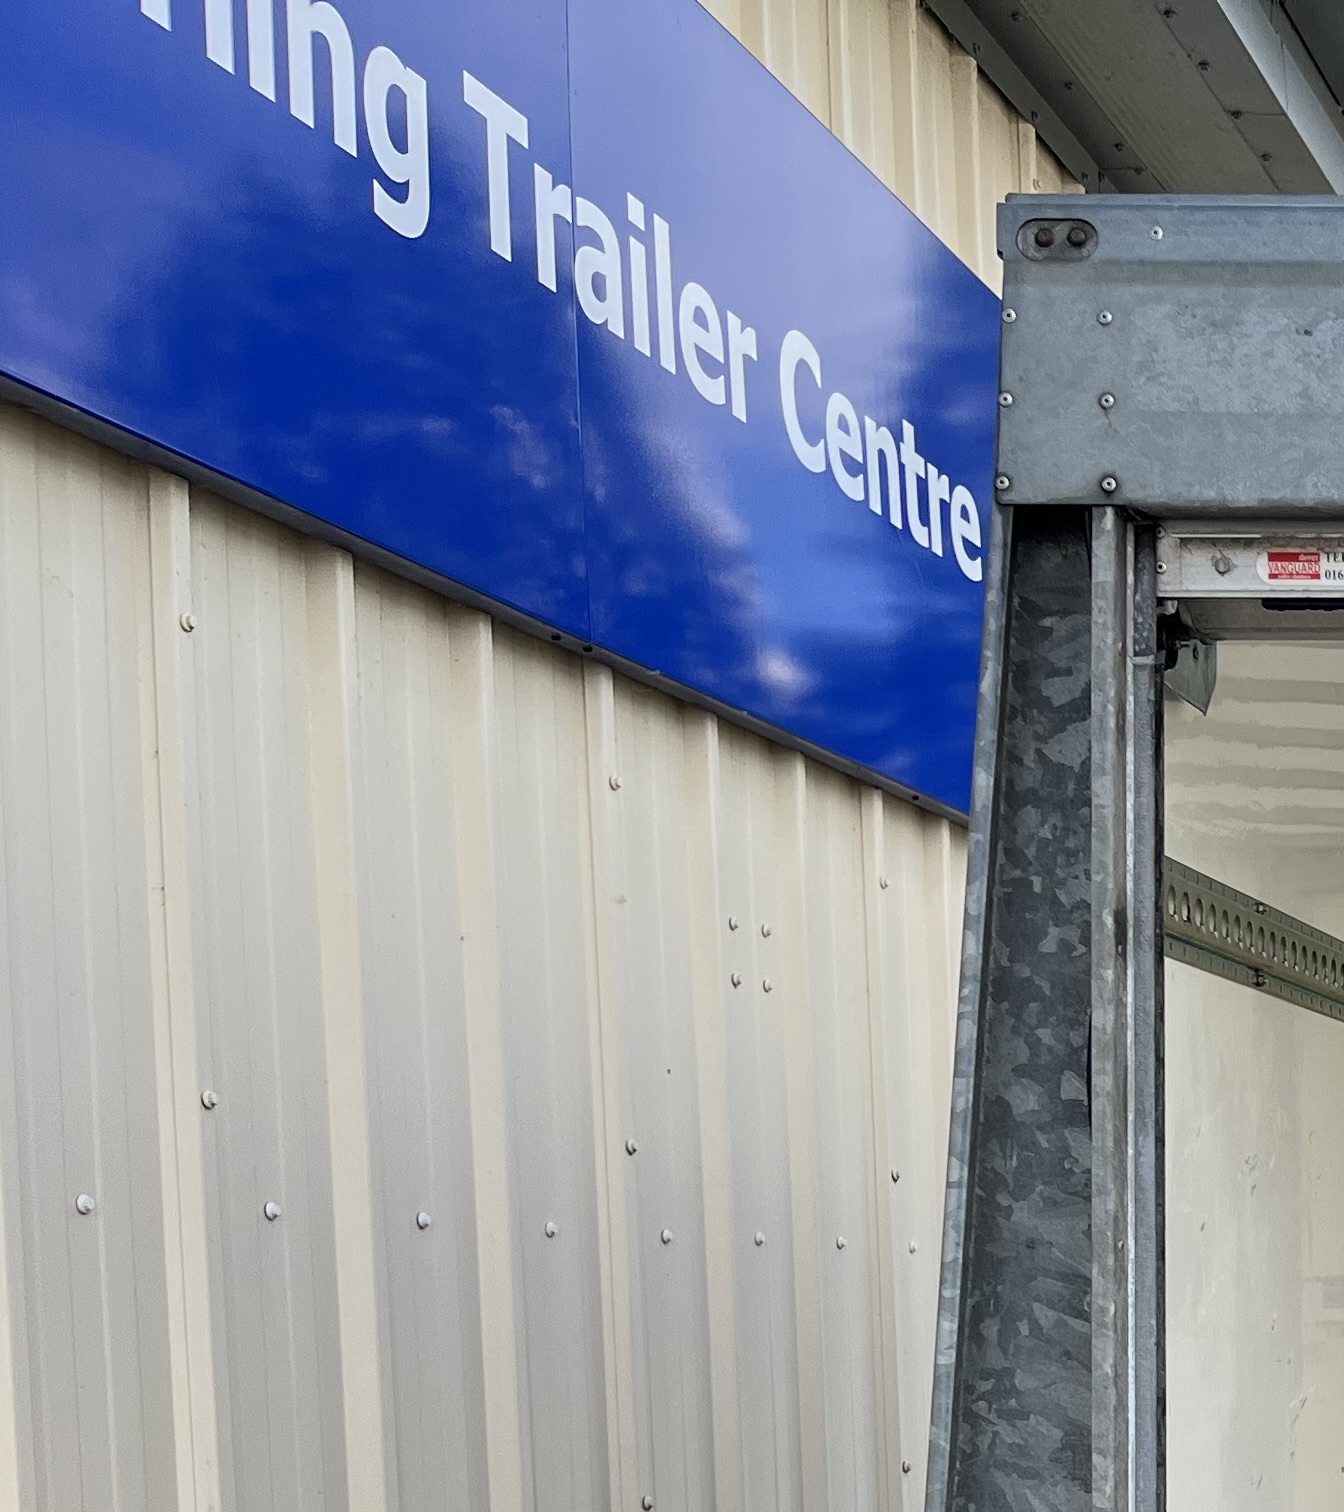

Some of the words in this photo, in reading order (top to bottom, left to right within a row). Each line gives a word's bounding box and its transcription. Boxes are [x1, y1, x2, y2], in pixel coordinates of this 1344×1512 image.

[462, 70, 757, 424] Trailer
[779, 330, 984, 583] Centre
[1268, 561, 1320, 575] VANGUARD
